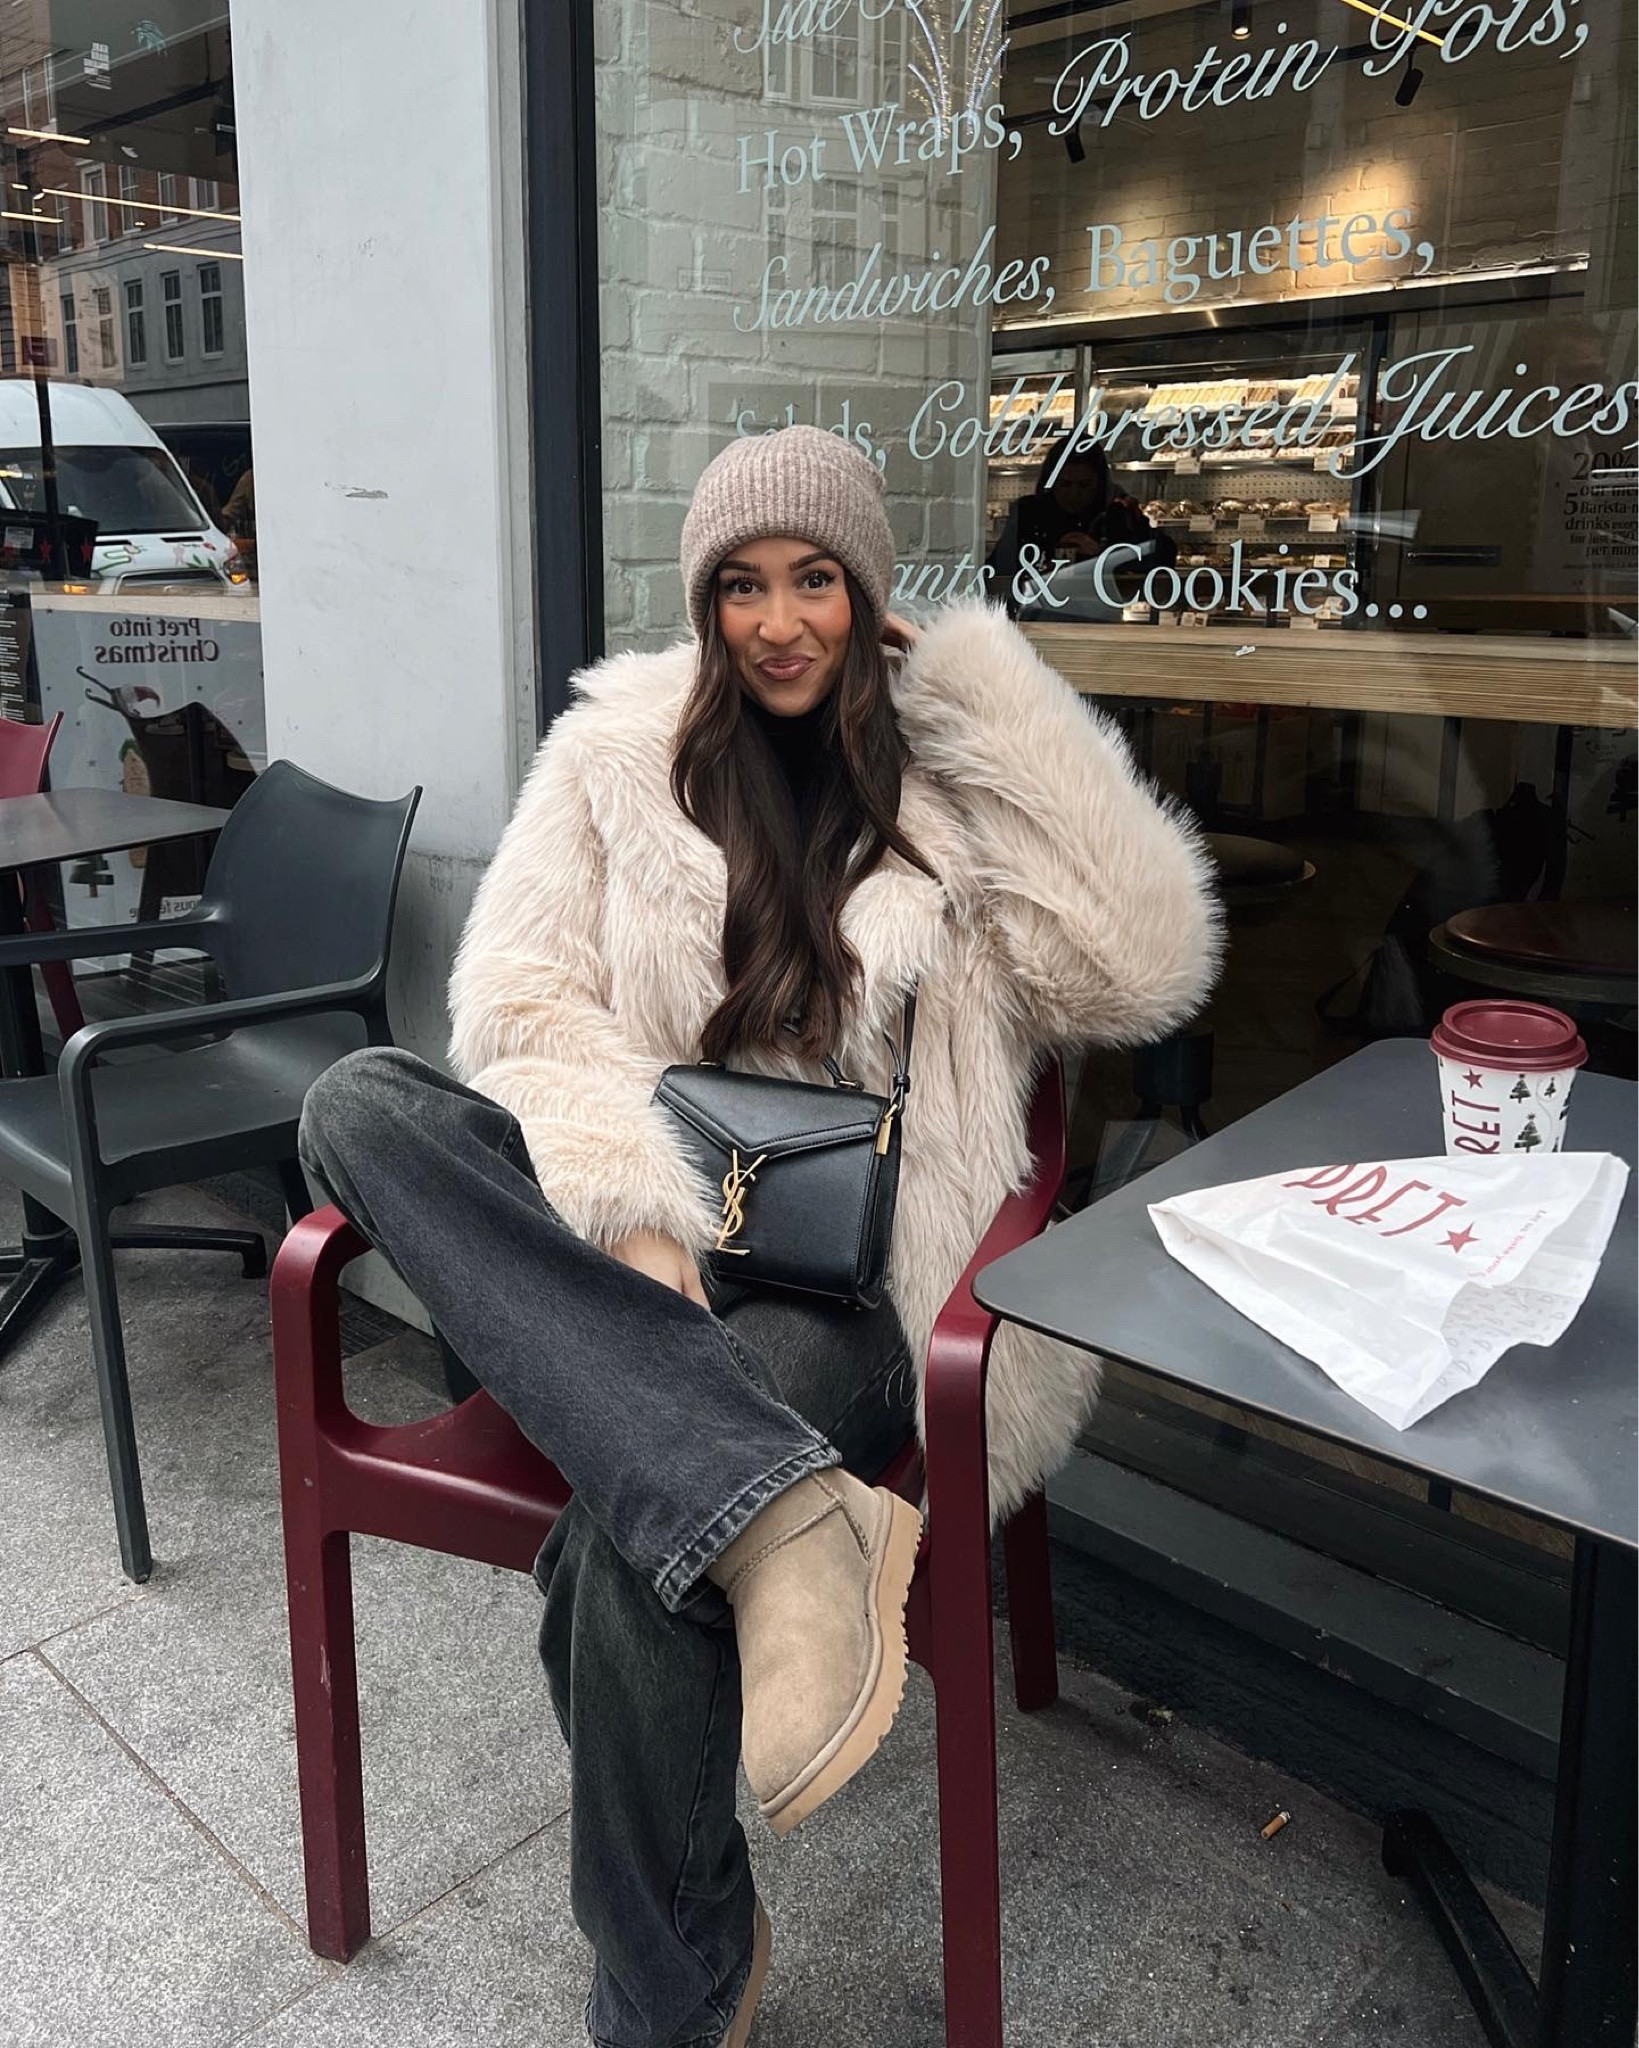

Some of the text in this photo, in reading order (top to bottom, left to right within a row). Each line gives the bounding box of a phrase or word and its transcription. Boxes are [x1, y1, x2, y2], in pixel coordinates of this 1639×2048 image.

[736, 129, 827, 194] Hot
[838, 102, 1023, 176] Wraps,
[1048, 22, 1338, 137] Protein
[733, 205, 1435, 332] Sandwiches, Baguettes,
[908, 353, 1357, 488] Cold-pressed
[1012, 543, 1070, 608] &
[1093, 539, 1428, 620] Cookies...
[1452, 1090, 1501, 1154] RET
[709, 1148, 769, 1256] YSL
